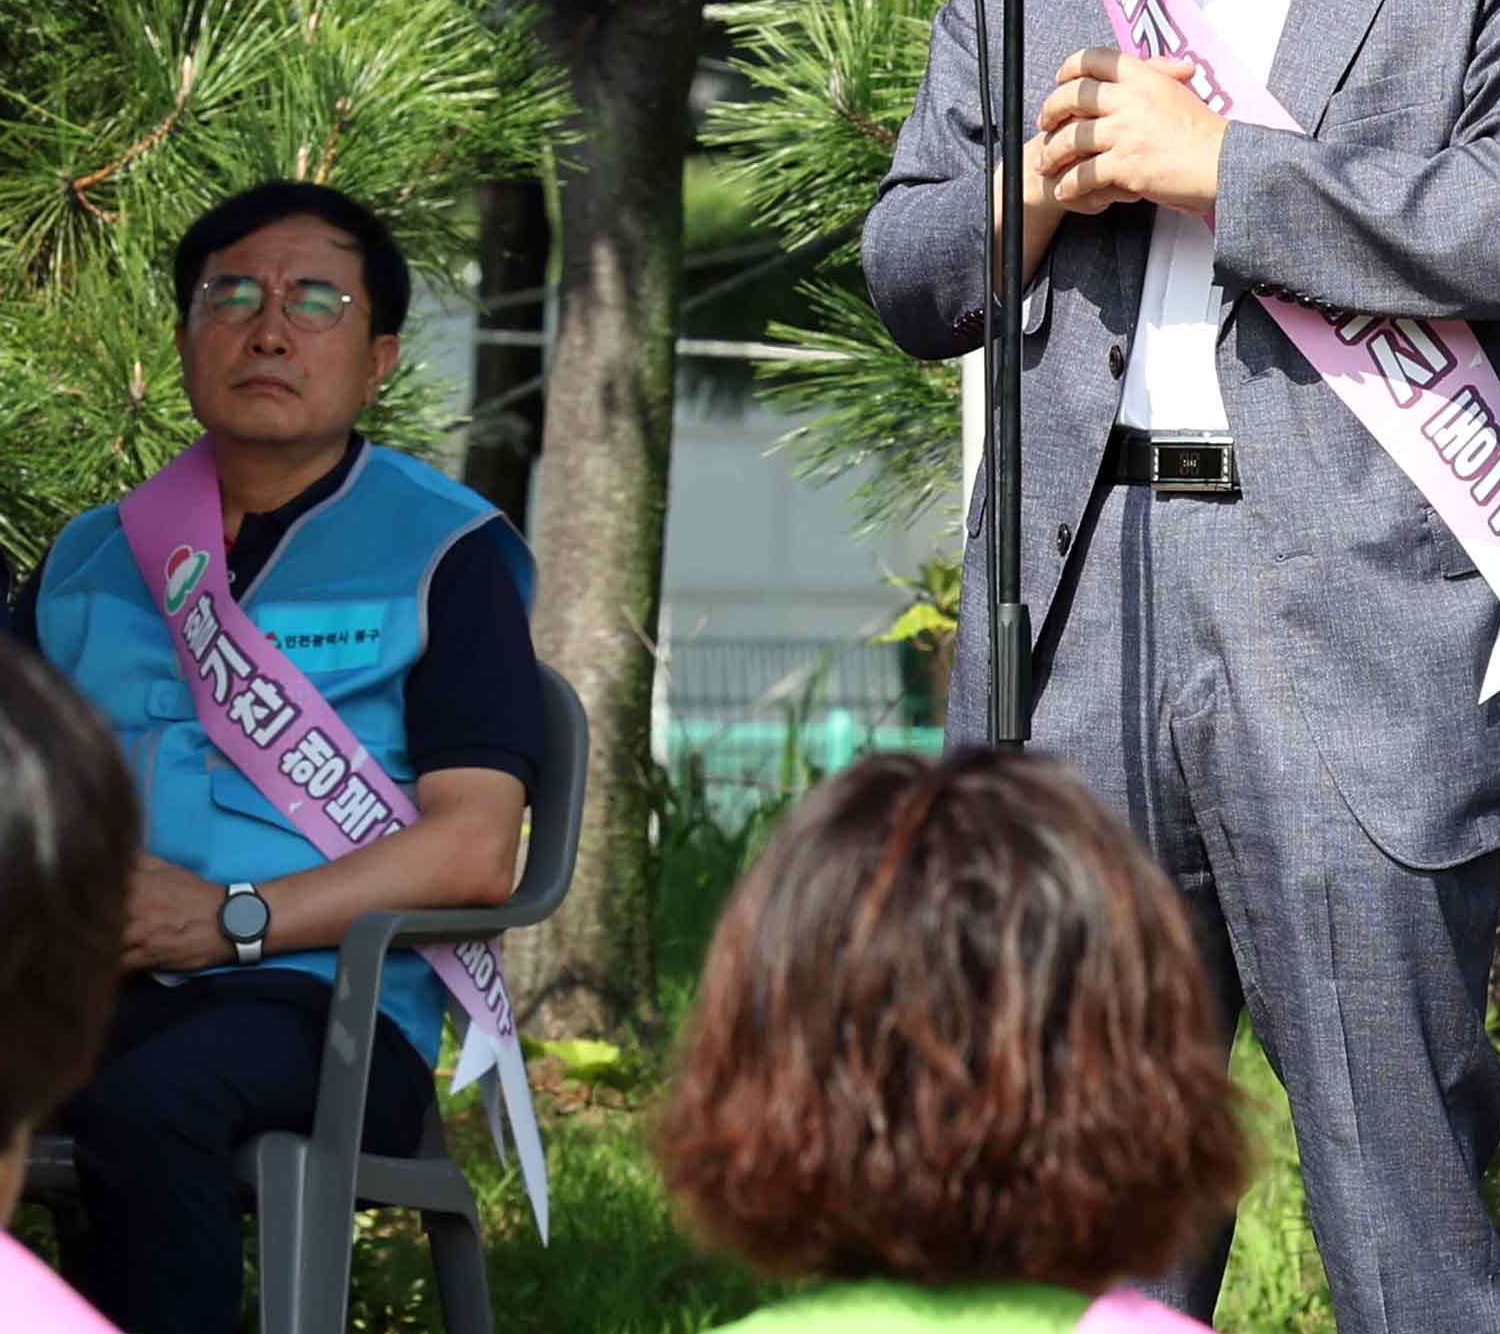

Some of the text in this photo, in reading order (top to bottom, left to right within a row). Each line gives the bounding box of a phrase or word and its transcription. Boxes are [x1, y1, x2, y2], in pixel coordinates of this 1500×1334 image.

[285, 628, 380, 650] 인천광역시 동구
[182, 592, 406, 845] 활기찬 행복
